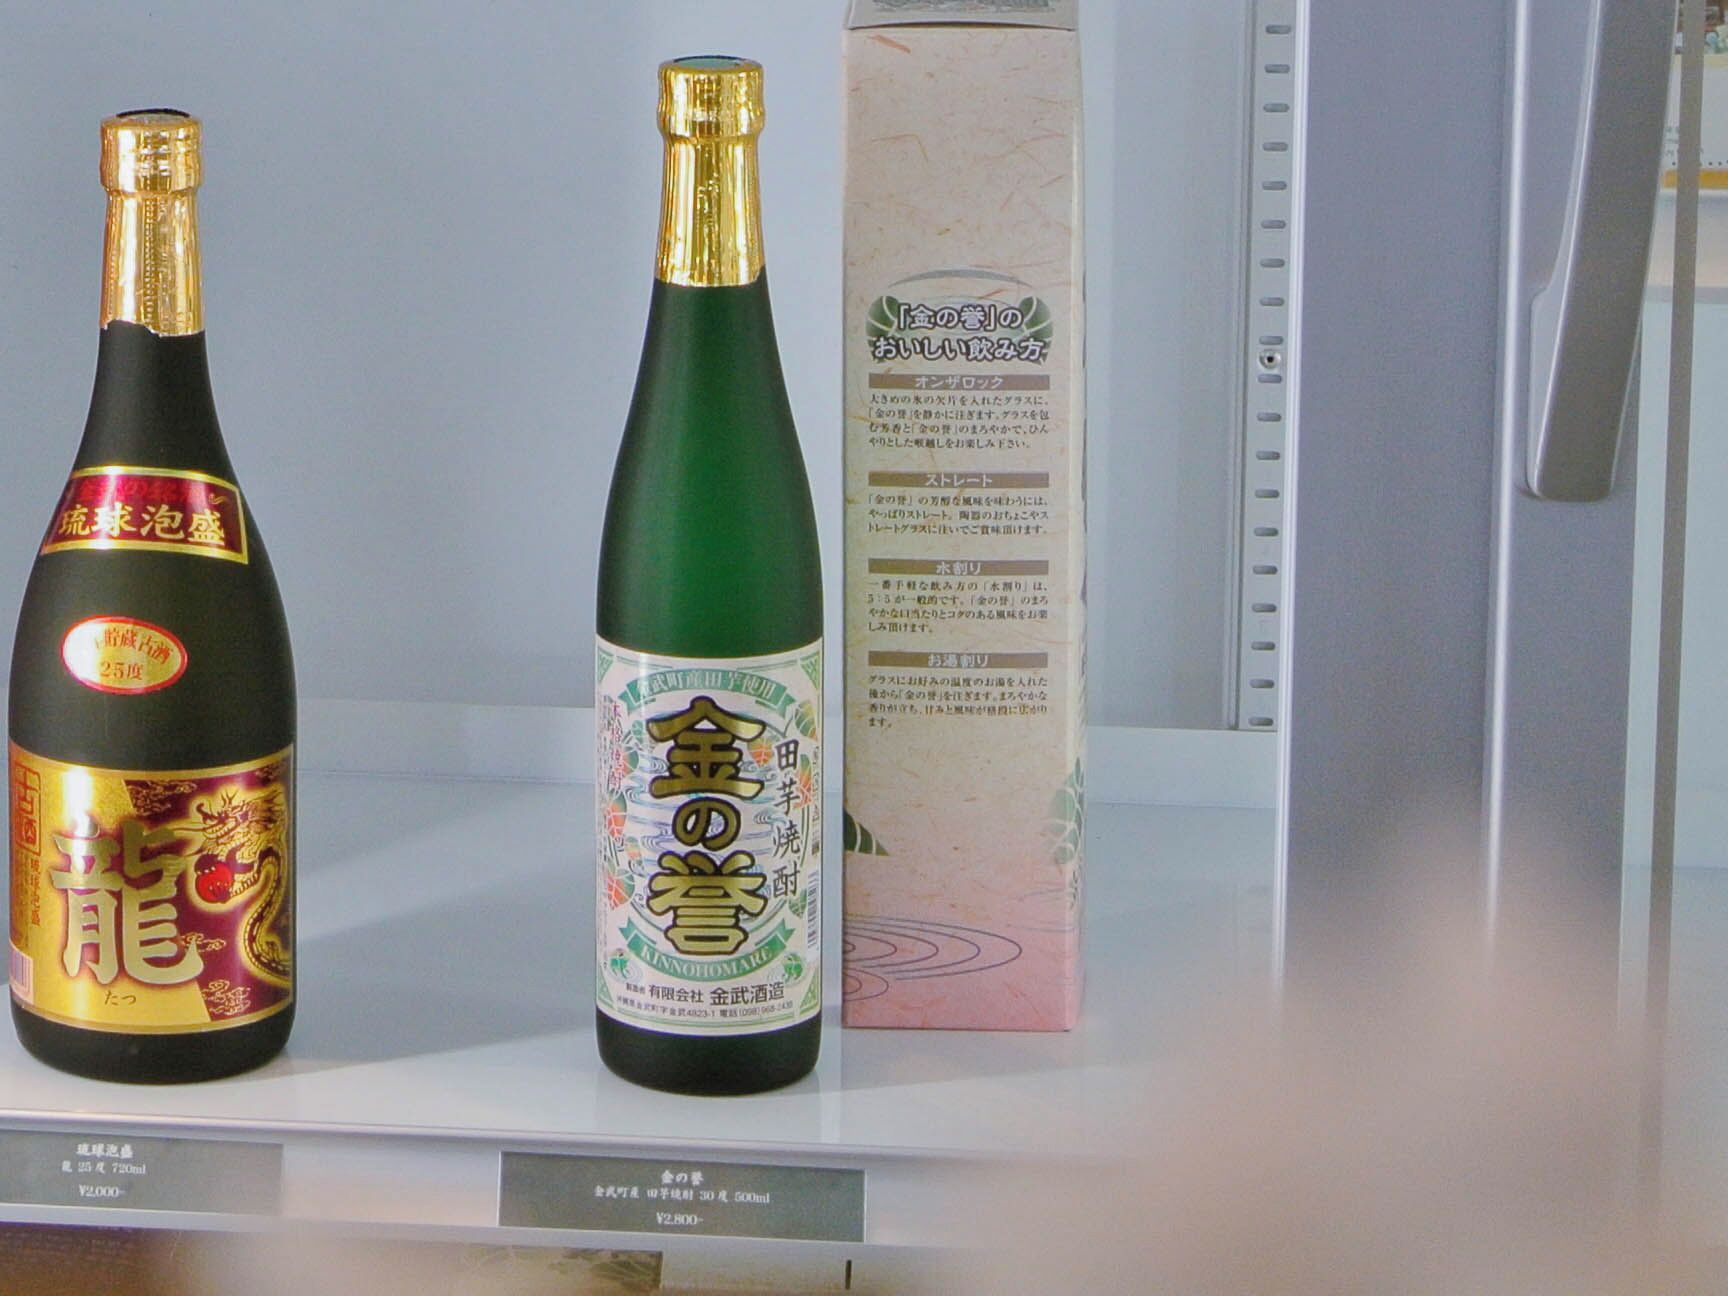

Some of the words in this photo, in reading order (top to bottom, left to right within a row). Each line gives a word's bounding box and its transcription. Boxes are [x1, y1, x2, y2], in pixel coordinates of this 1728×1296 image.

[874, 337, 1045, 362] おいしい飲み方
[915, 376, 1003, 389] オンザロック
[924, 474, 993, 487] ストレート
[58, 502, 225, 546] 琉球泡盛
[936, 561, 982, 575] 水割り
[928, 654, 989, 668] お湯割り
[100, 661, 143, 681] 25度
[646, 695, 768, 956] 金の誉
[772, 739, 801, 898] 田芋焼酎
[50, 811, 204, 984] 龍
[640, 944, 771, 978] KINNOHOMARE
[104, 990, 136, 1006] たつ
[649, 984, 704, 1004] 有限会社
[710, 981, 785, 1006] 金武酒造
[76, 1142, 134, 1159] 琉球泡盛
[660, 1170, 704, 1186] 金の誉
[734, 1192, 770, 1204] 500ml
